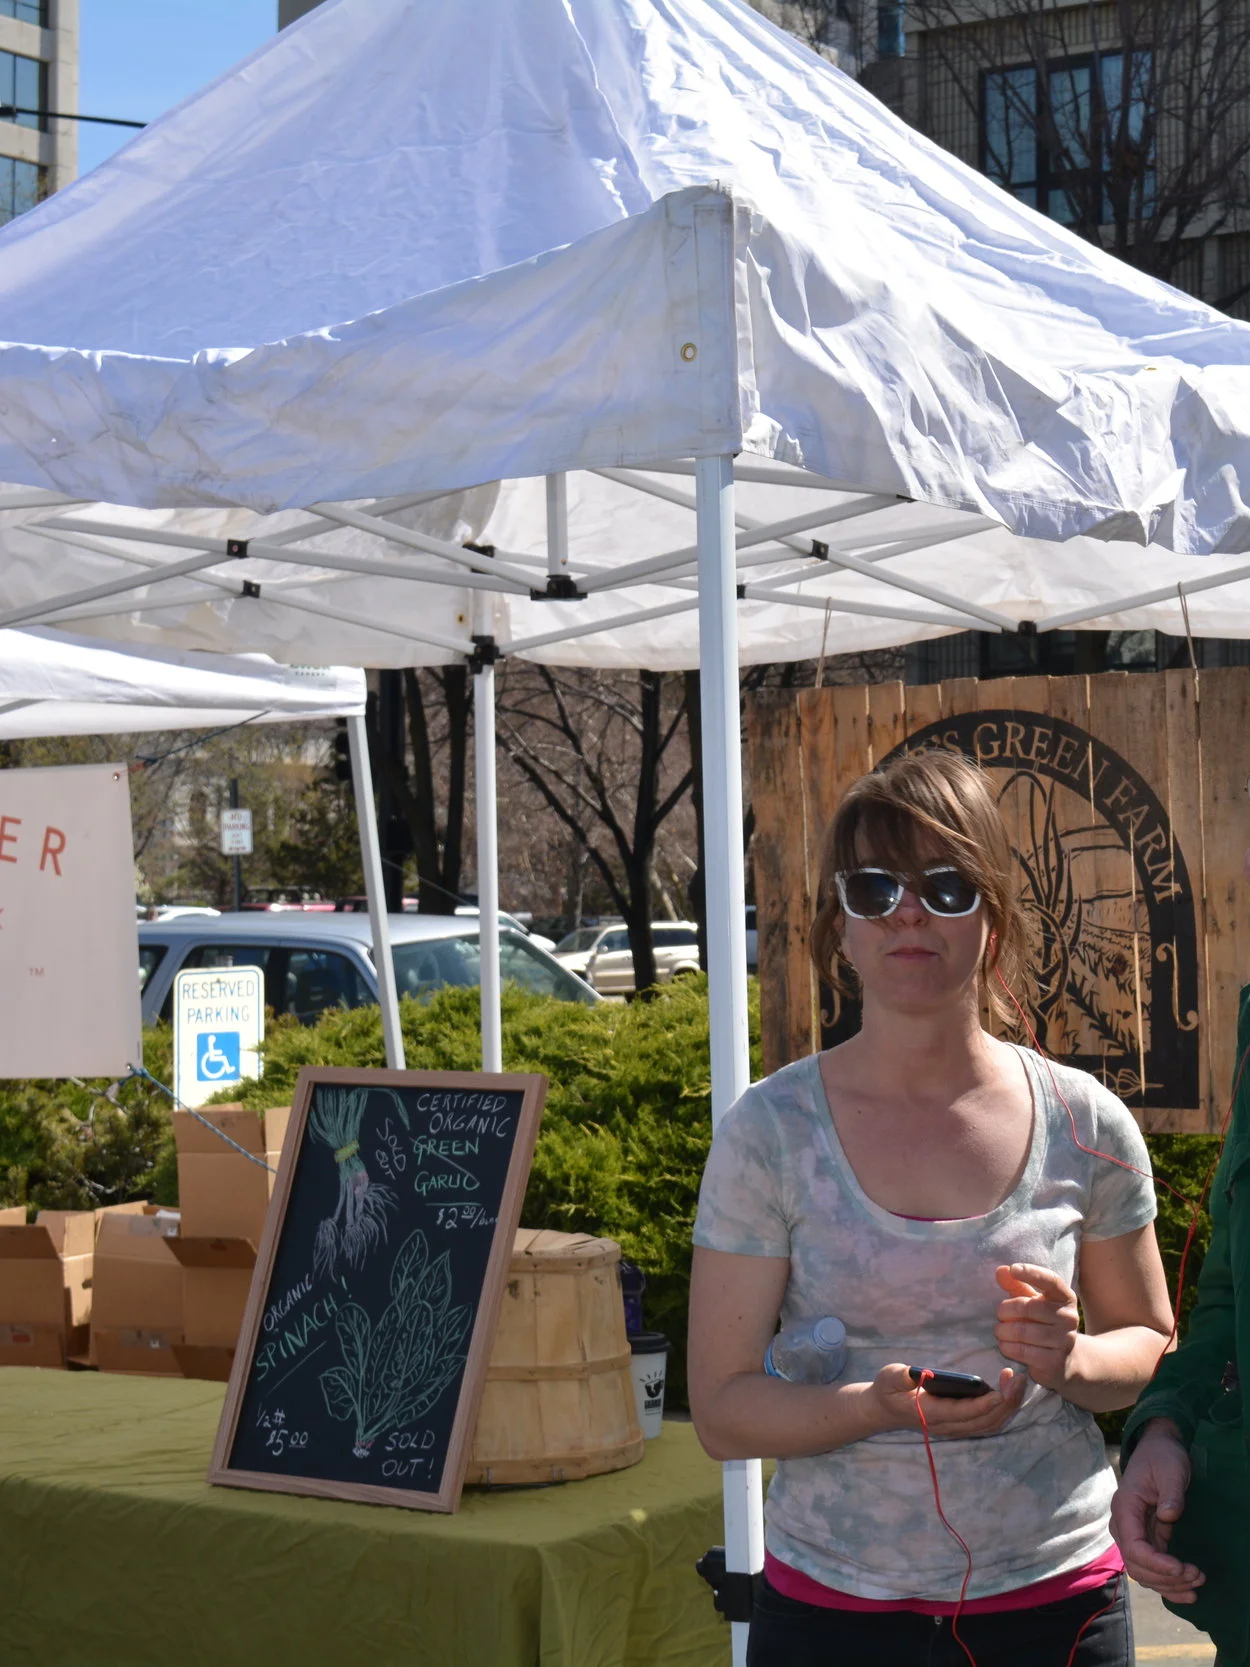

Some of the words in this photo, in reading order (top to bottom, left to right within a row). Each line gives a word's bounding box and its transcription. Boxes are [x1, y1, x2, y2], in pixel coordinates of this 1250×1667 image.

[973, 720, 1111, 790] GREEN
[1103, 775, 1183, 905] FARM
[182, 980, 255, 1001] RESERVED
[187, 1005, 250, 1025] PARKING
[416, 1093, 507, 1113] CERTIFIED
[429, 1113, 511, 1137] ORGANIC
[376, 1118, 406, 1172] SOLD
[413, 1135, 479, 1165] GREEN
[263, 1273, 313, 1332] ORGANIC
[384, 1429, 435, 1451] SOLD
[381, 1457, 435, 1479] OUT!
